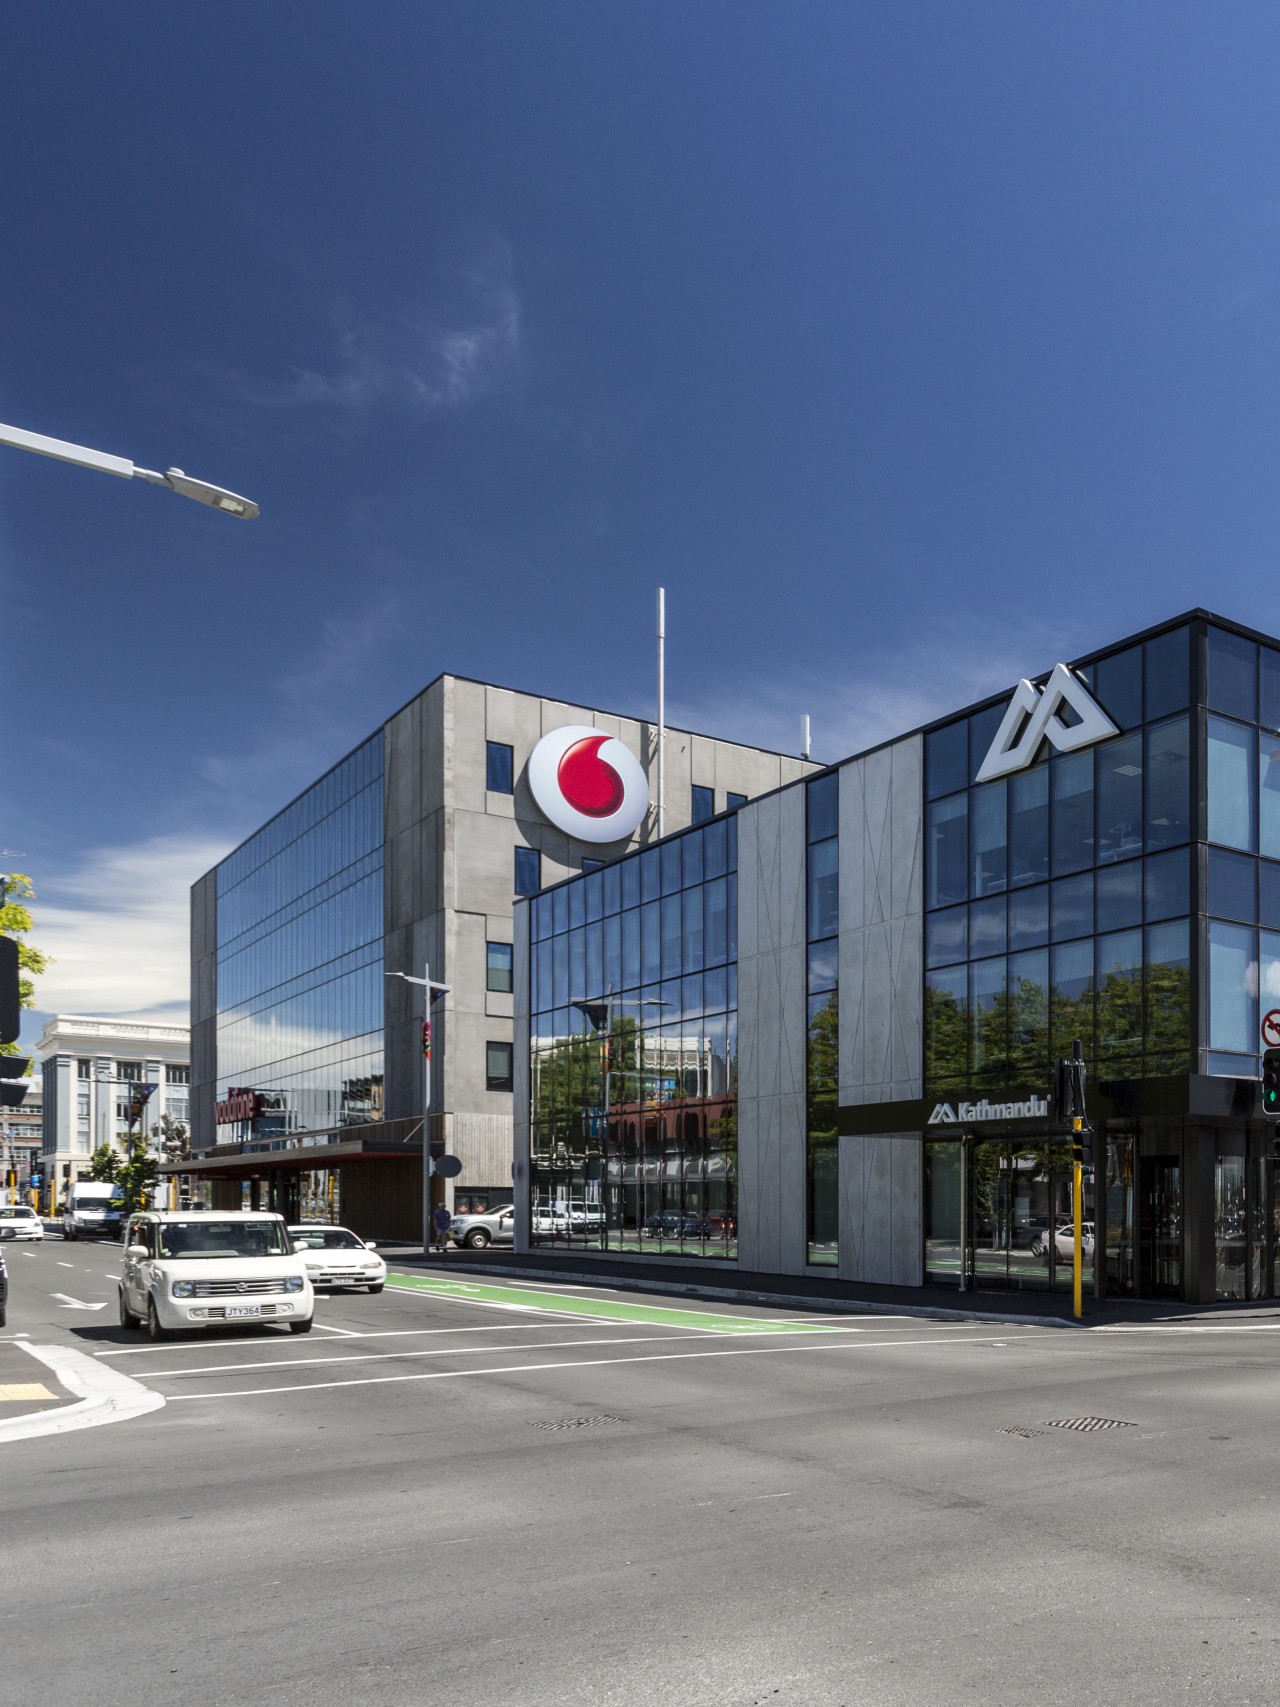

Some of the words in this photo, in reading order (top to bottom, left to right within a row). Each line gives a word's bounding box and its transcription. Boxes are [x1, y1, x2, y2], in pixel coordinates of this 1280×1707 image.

[214, 1088, 255, 1124] vodafone
[958, 1094, 1048, 1122] Kathmandu
[227, 1307, 260, 1316] JTY364
